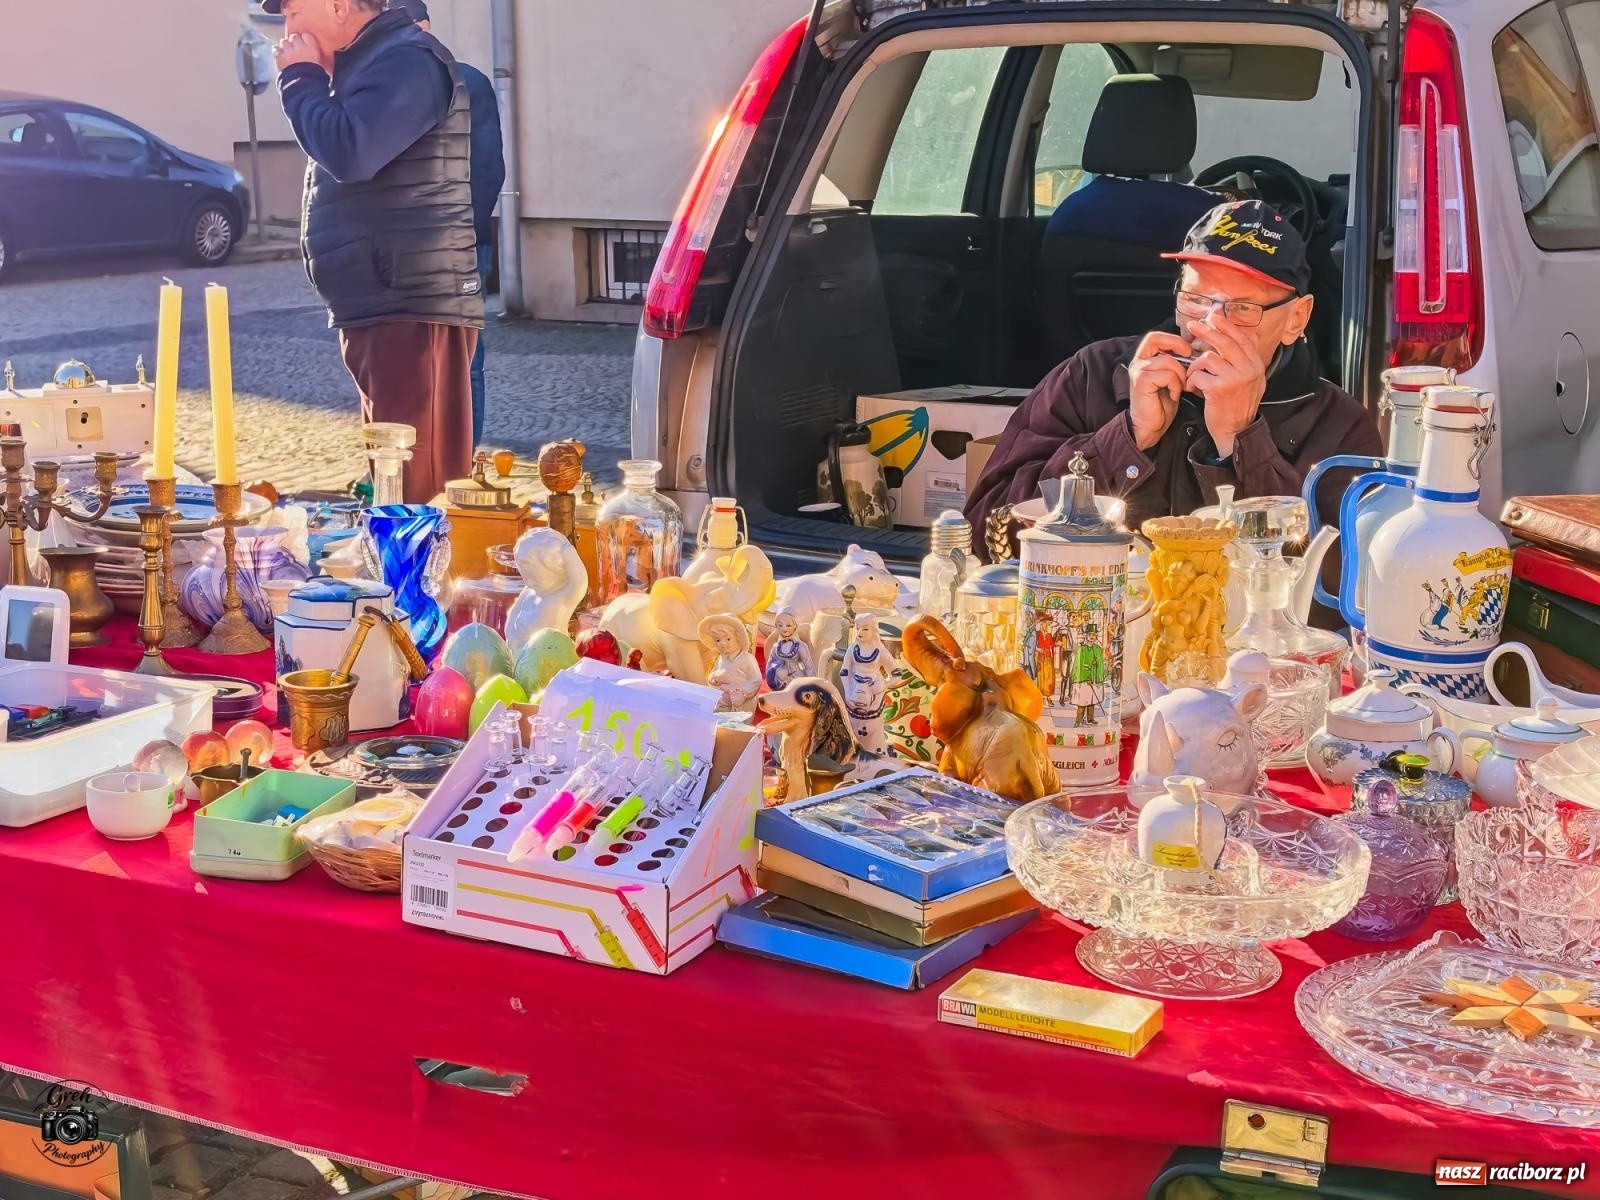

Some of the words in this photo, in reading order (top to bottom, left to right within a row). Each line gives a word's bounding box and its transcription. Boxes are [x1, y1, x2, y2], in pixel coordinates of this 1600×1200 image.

[1208, 214, 1279, 255] Yankees
[1260, 225, 1283, 241] YORK
[943, 999, 976, 1017] BRAWA
